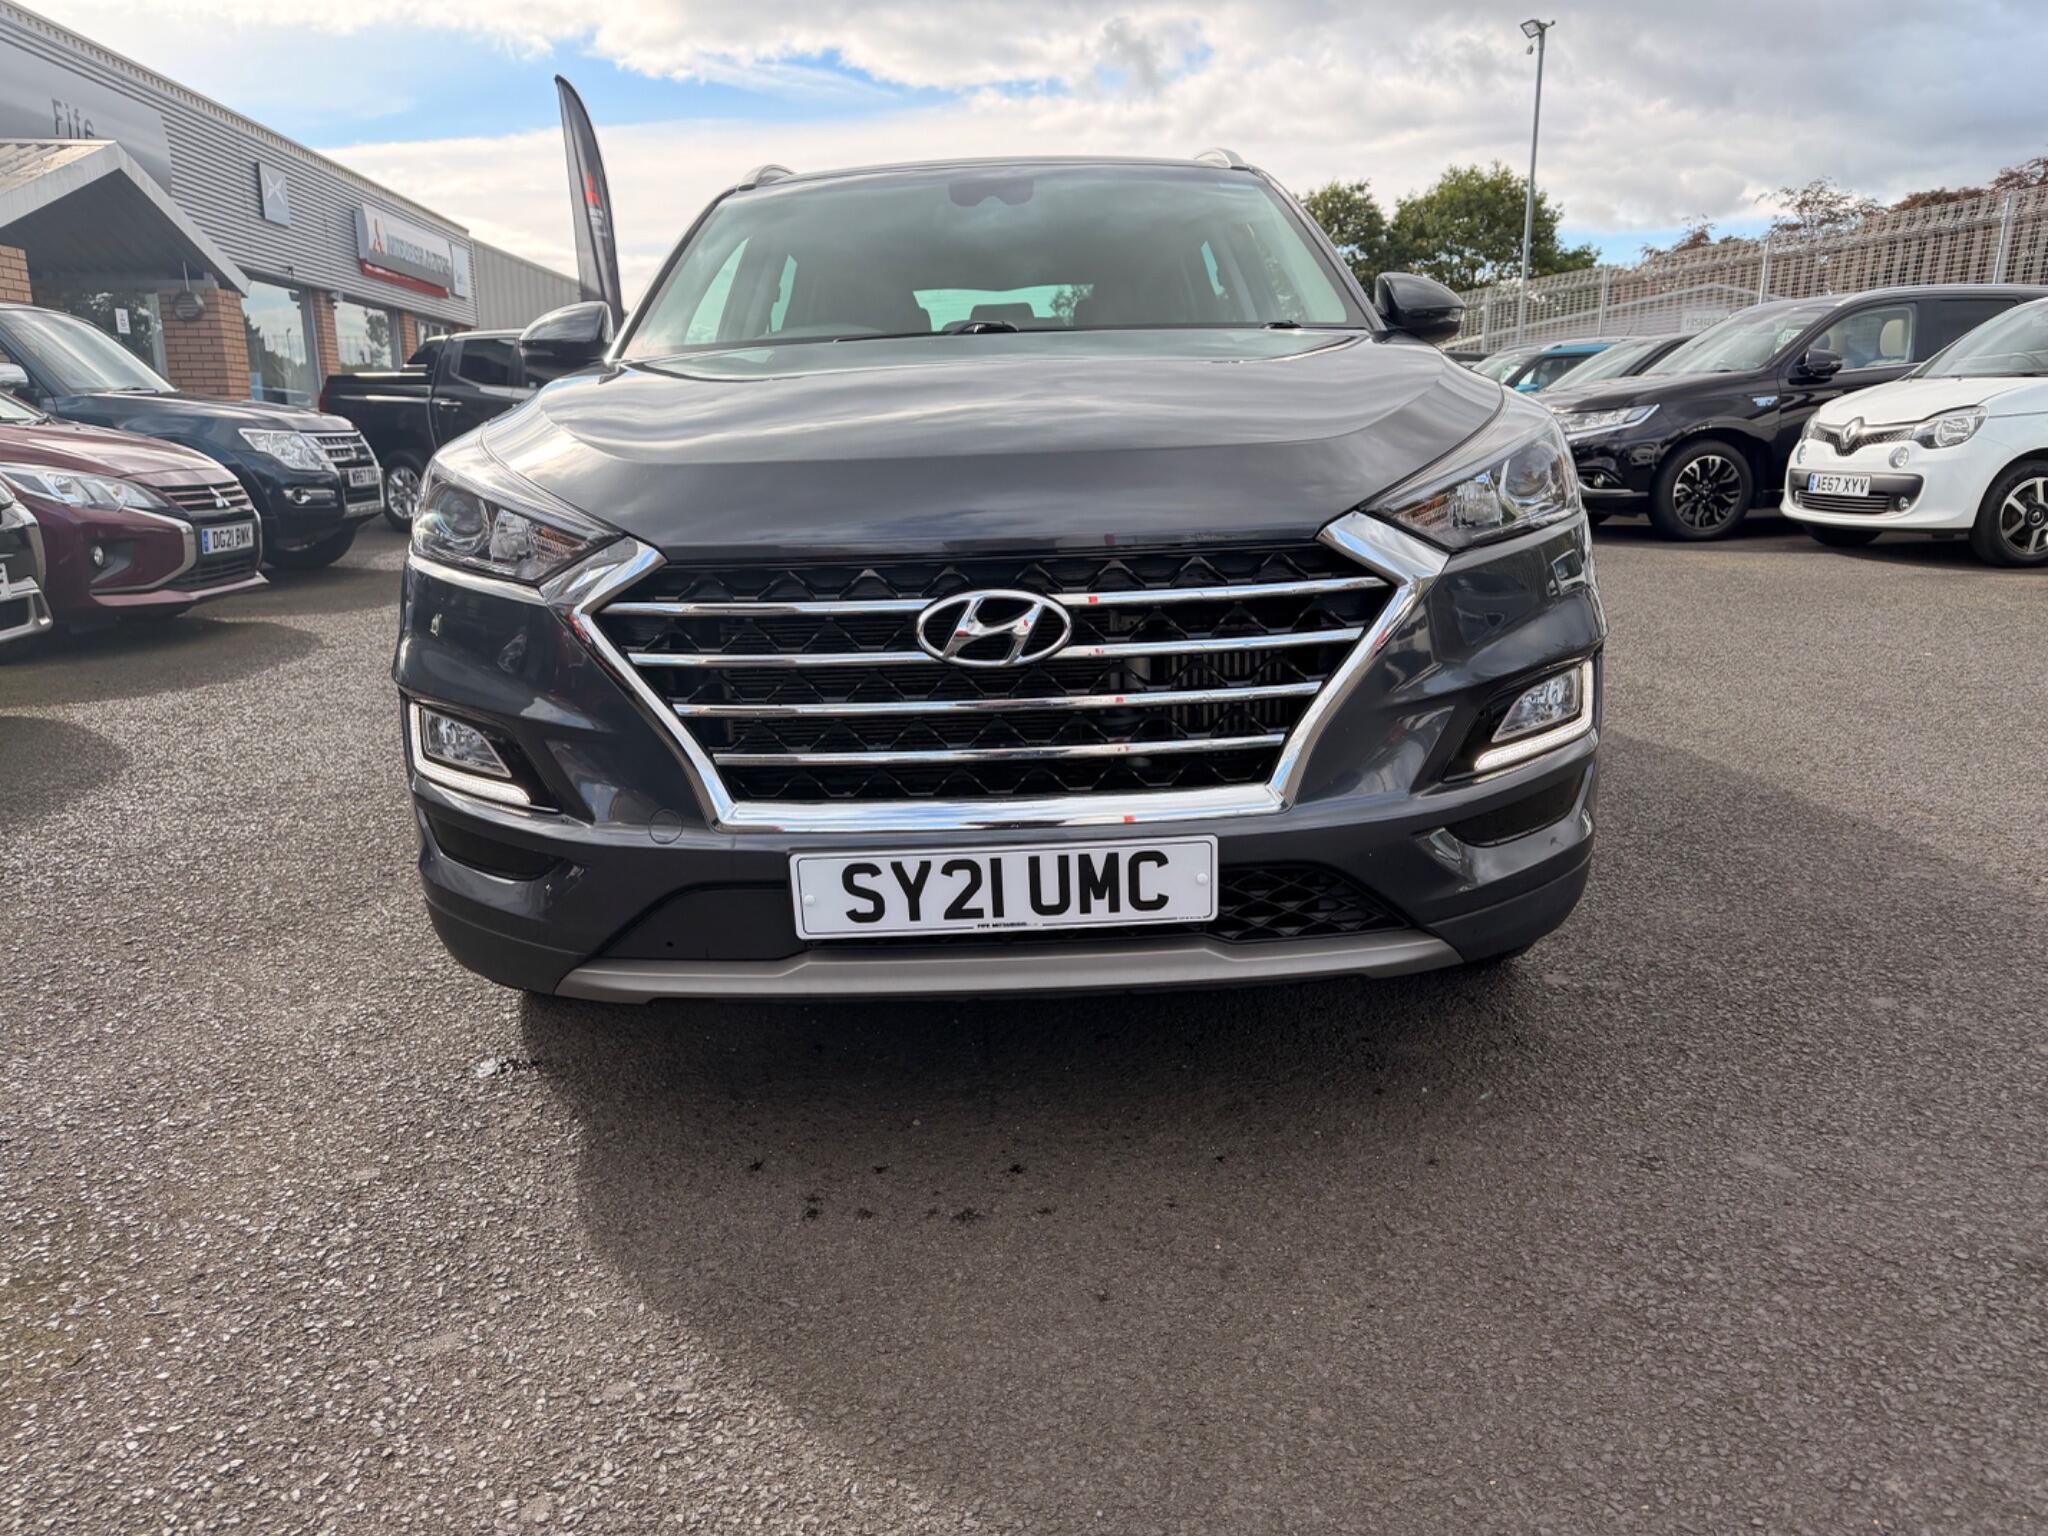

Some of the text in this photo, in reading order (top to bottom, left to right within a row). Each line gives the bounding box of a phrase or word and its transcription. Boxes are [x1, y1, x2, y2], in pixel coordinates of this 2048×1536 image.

[52, 98, 95, 139] Fife
[1816, 476, 1840, 491] AE67
[212, 529, 234, 549] DG21
[841, 850, 1170, 923] SY21 UMC
